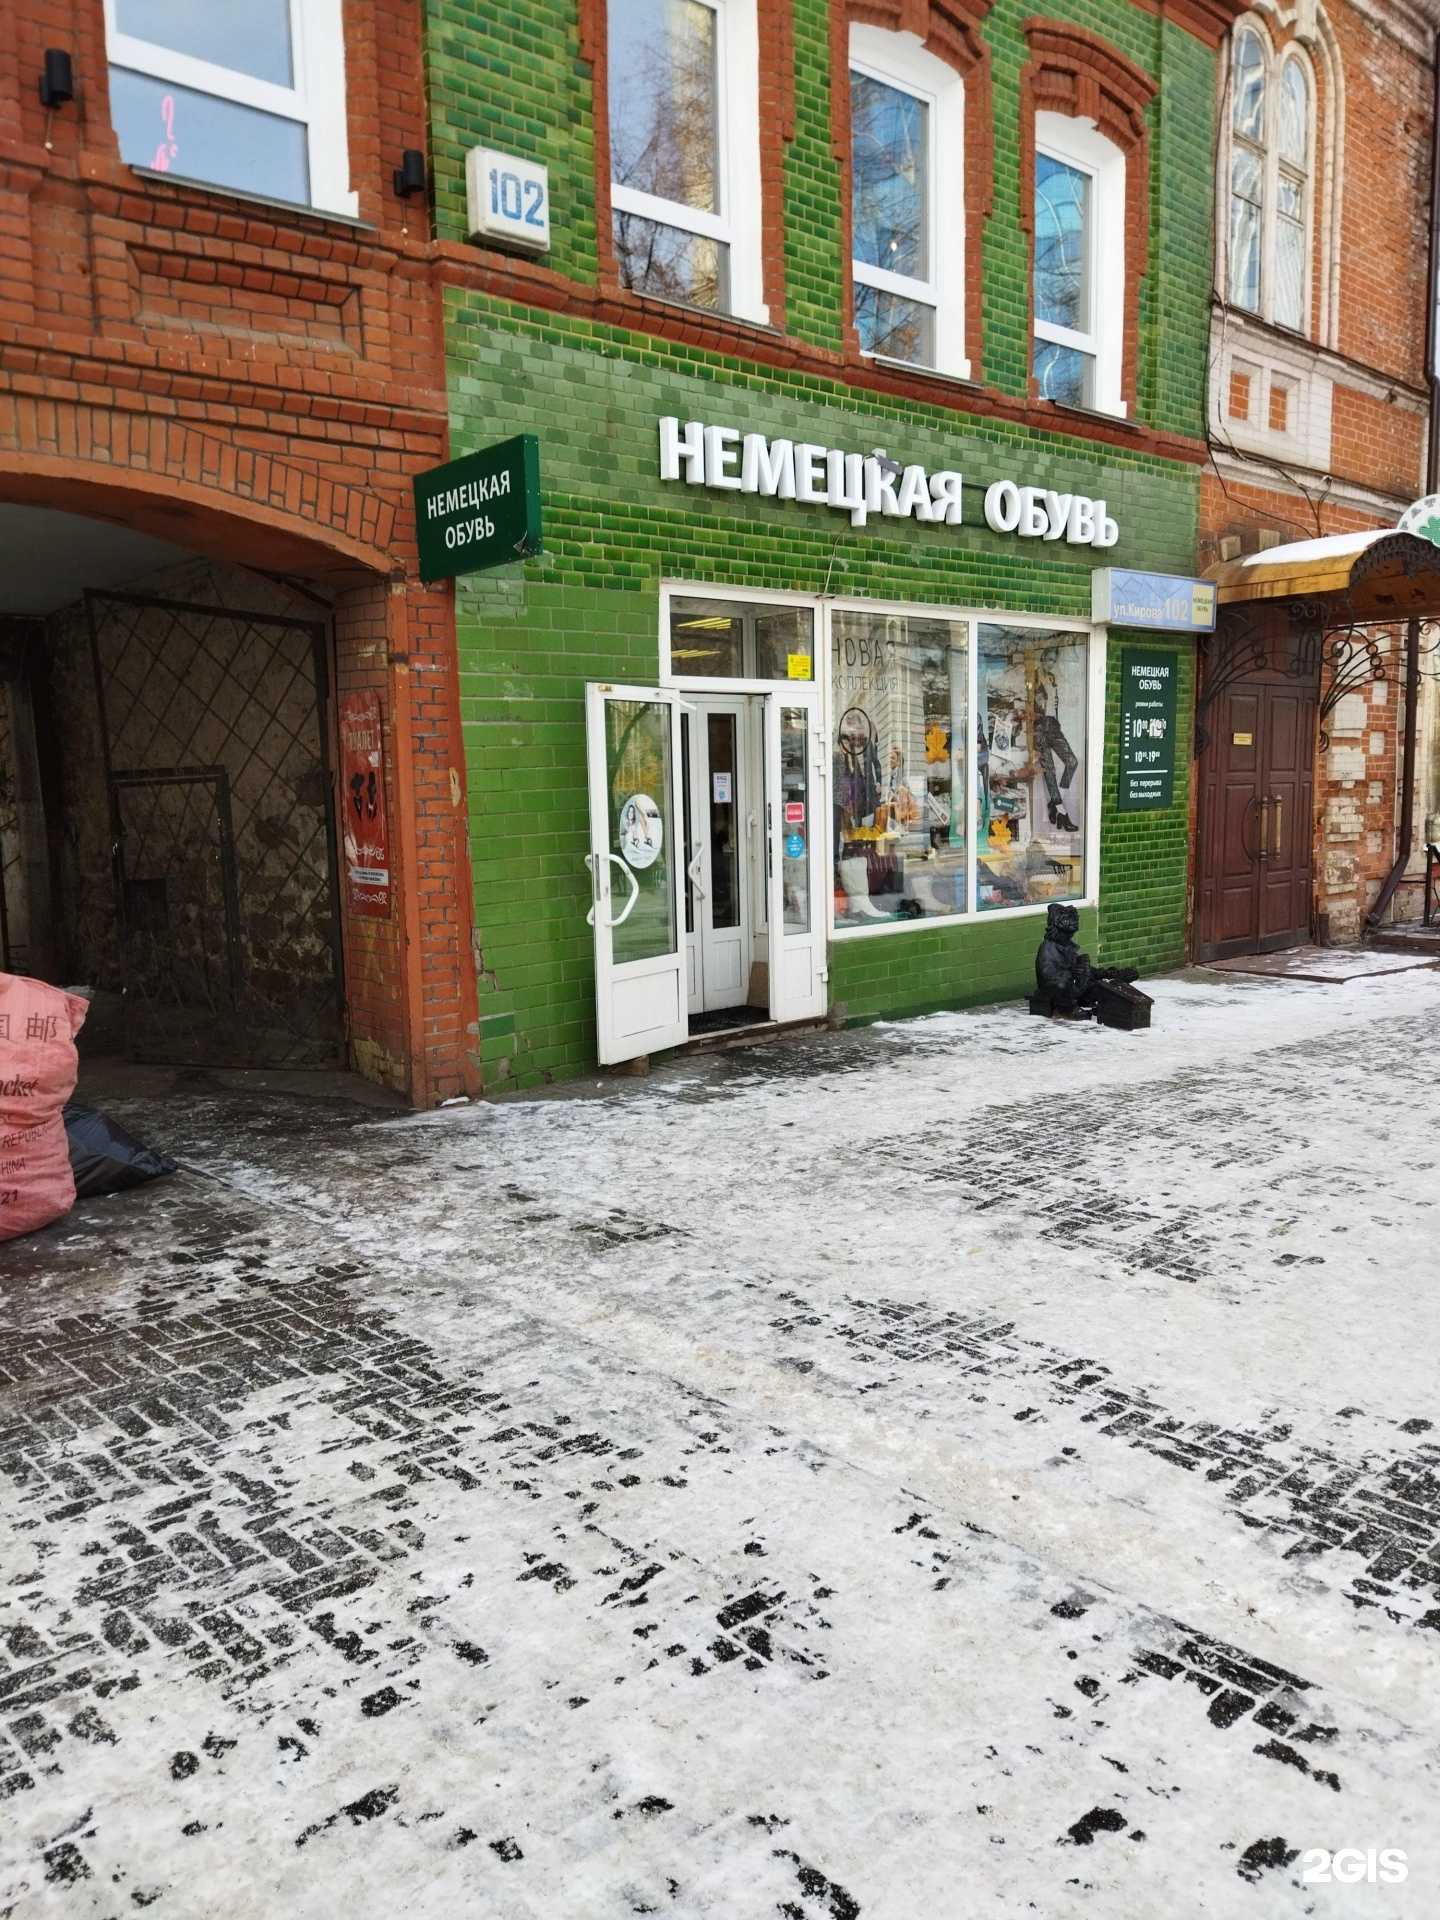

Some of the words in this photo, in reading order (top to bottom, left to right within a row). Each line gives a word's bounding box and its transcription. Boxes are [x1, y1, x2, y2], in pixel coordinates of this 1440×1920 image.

[488, 168, 545, 227] 102
[427, 469, 511, 520] НЕМЕЦКАЯ
[659, 416, 963, 527] НЕМЕЦКАЯ
[984, 479, 1119, 548] ОБУВЬ
[445, 515, 496, 549] ОБУВЬ
[1131, 665, 1170, 678] НЕМЕЦКАЯ
[1139, 679, 1162, 691] ОБУВЬ
